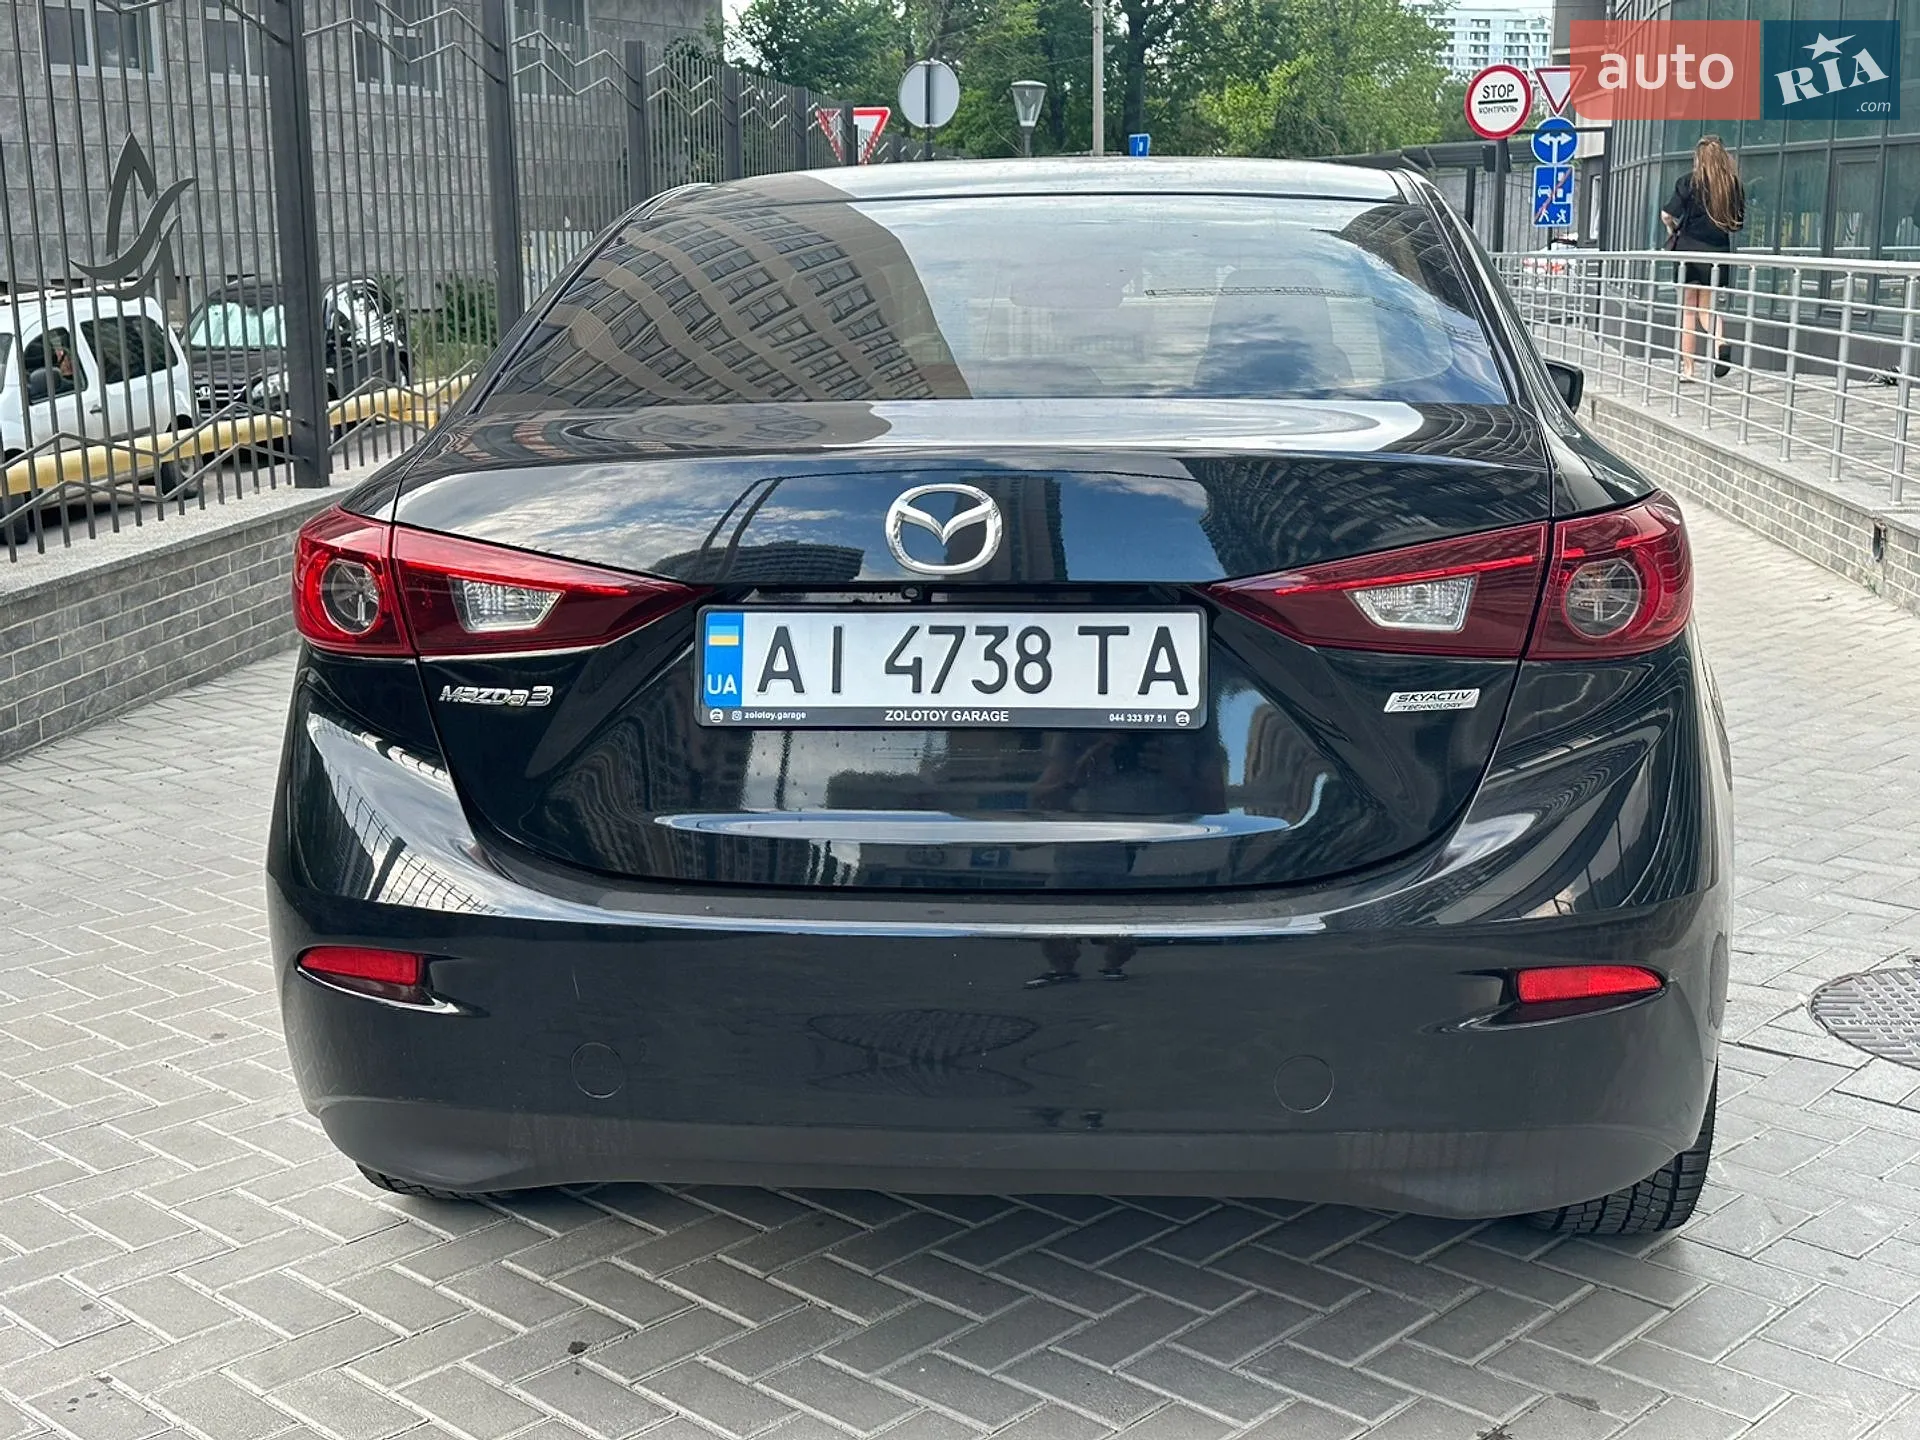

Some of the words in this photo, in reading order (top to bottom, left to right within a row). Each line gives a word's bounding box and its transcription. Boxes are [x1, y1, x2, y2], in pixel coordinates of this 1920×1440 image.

[1482, 83, 1515, 99] STOP
[757, 625, 843, 694] AI
[885, 625, 1053, 695] 4738
[1078, 625, 1189, 695] TA
[707, 674, 738, 694] UA
[1397, 691, 1472, 703] SKYACTIV
[1402, 702, 1463, 711] TECHNOLOGY
[885, 710, 948, 721] ZOLOTOY
[951, 710, 1009, 722] GARAGE
